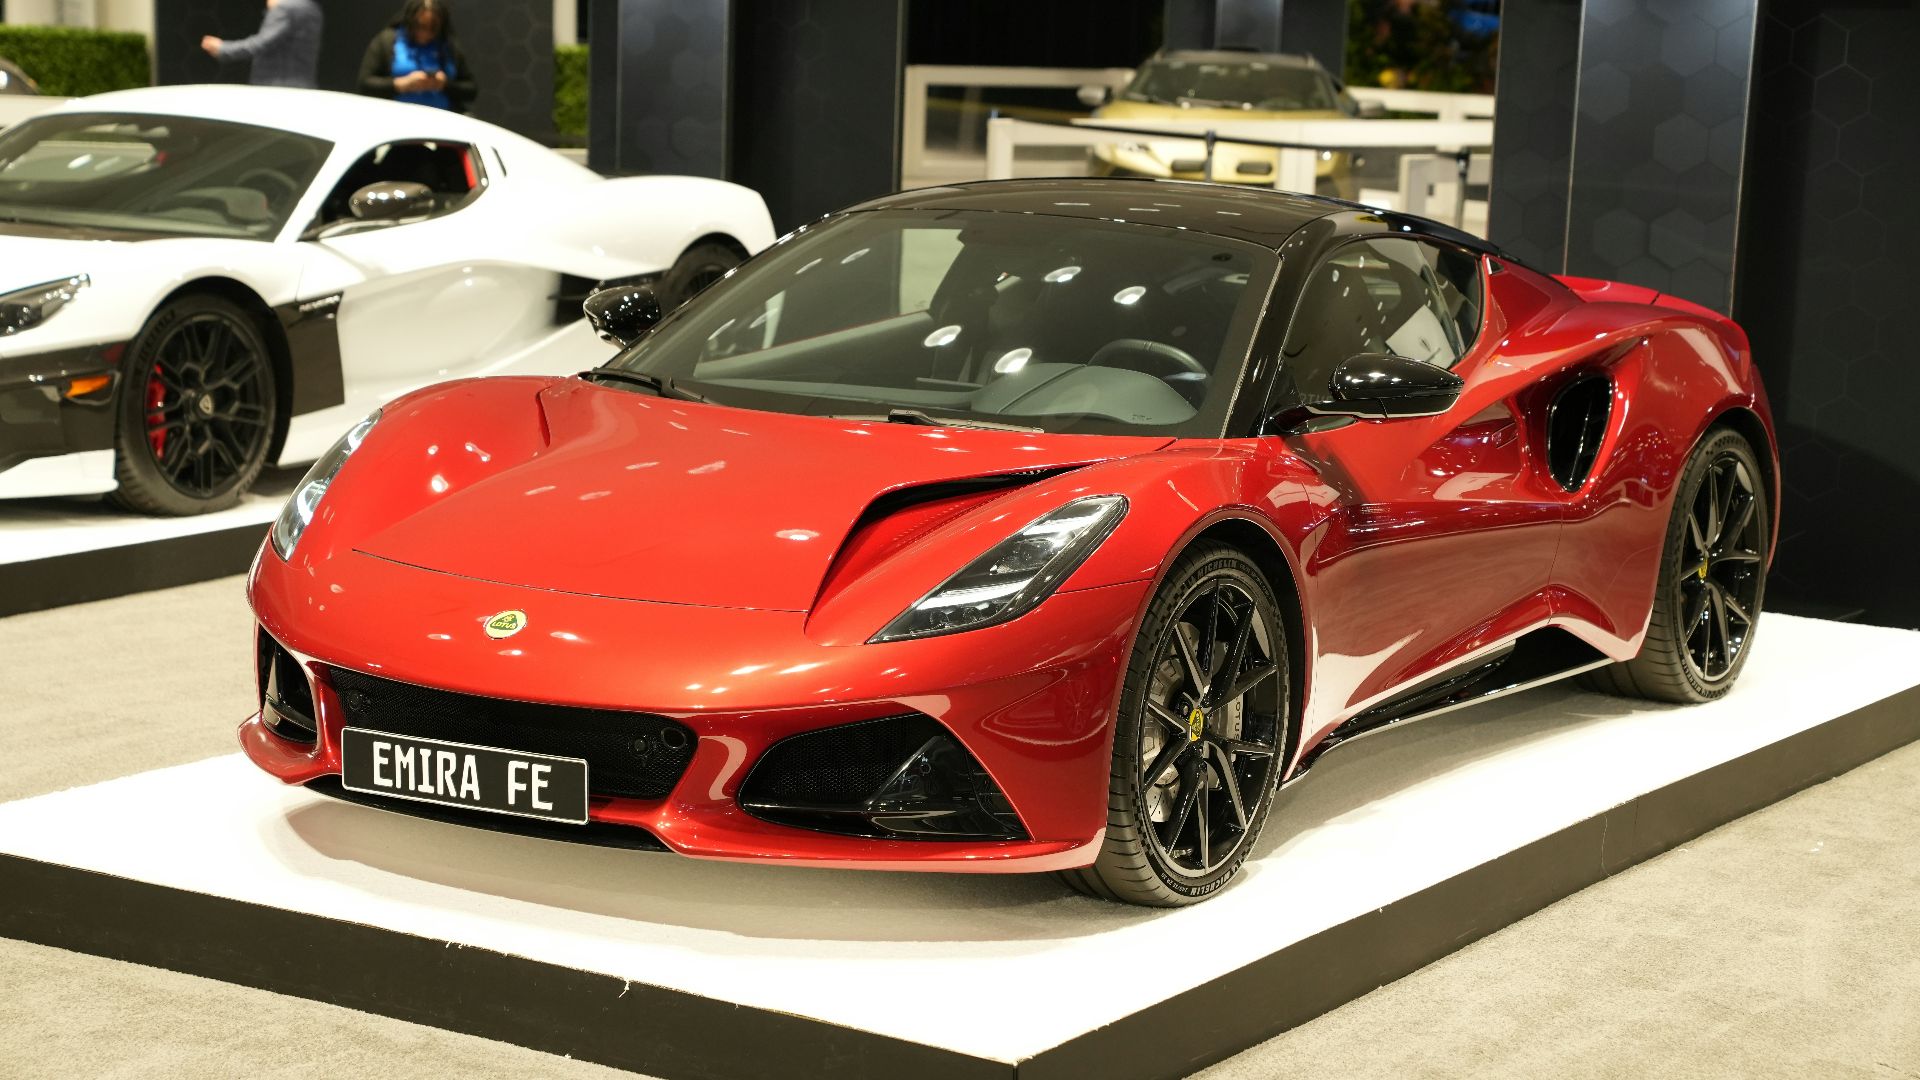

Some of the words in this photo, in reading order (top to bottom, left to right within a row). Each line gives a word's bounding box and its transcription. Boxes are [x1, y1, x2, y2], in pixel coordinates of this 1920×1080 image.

[1197, 560, 1237, 579] MICHELIN
[373, 741, 480, 801] EMIRA
[508, 760, 553, 811] FE
[1190, 871, 1231, 896] MICHELIN
